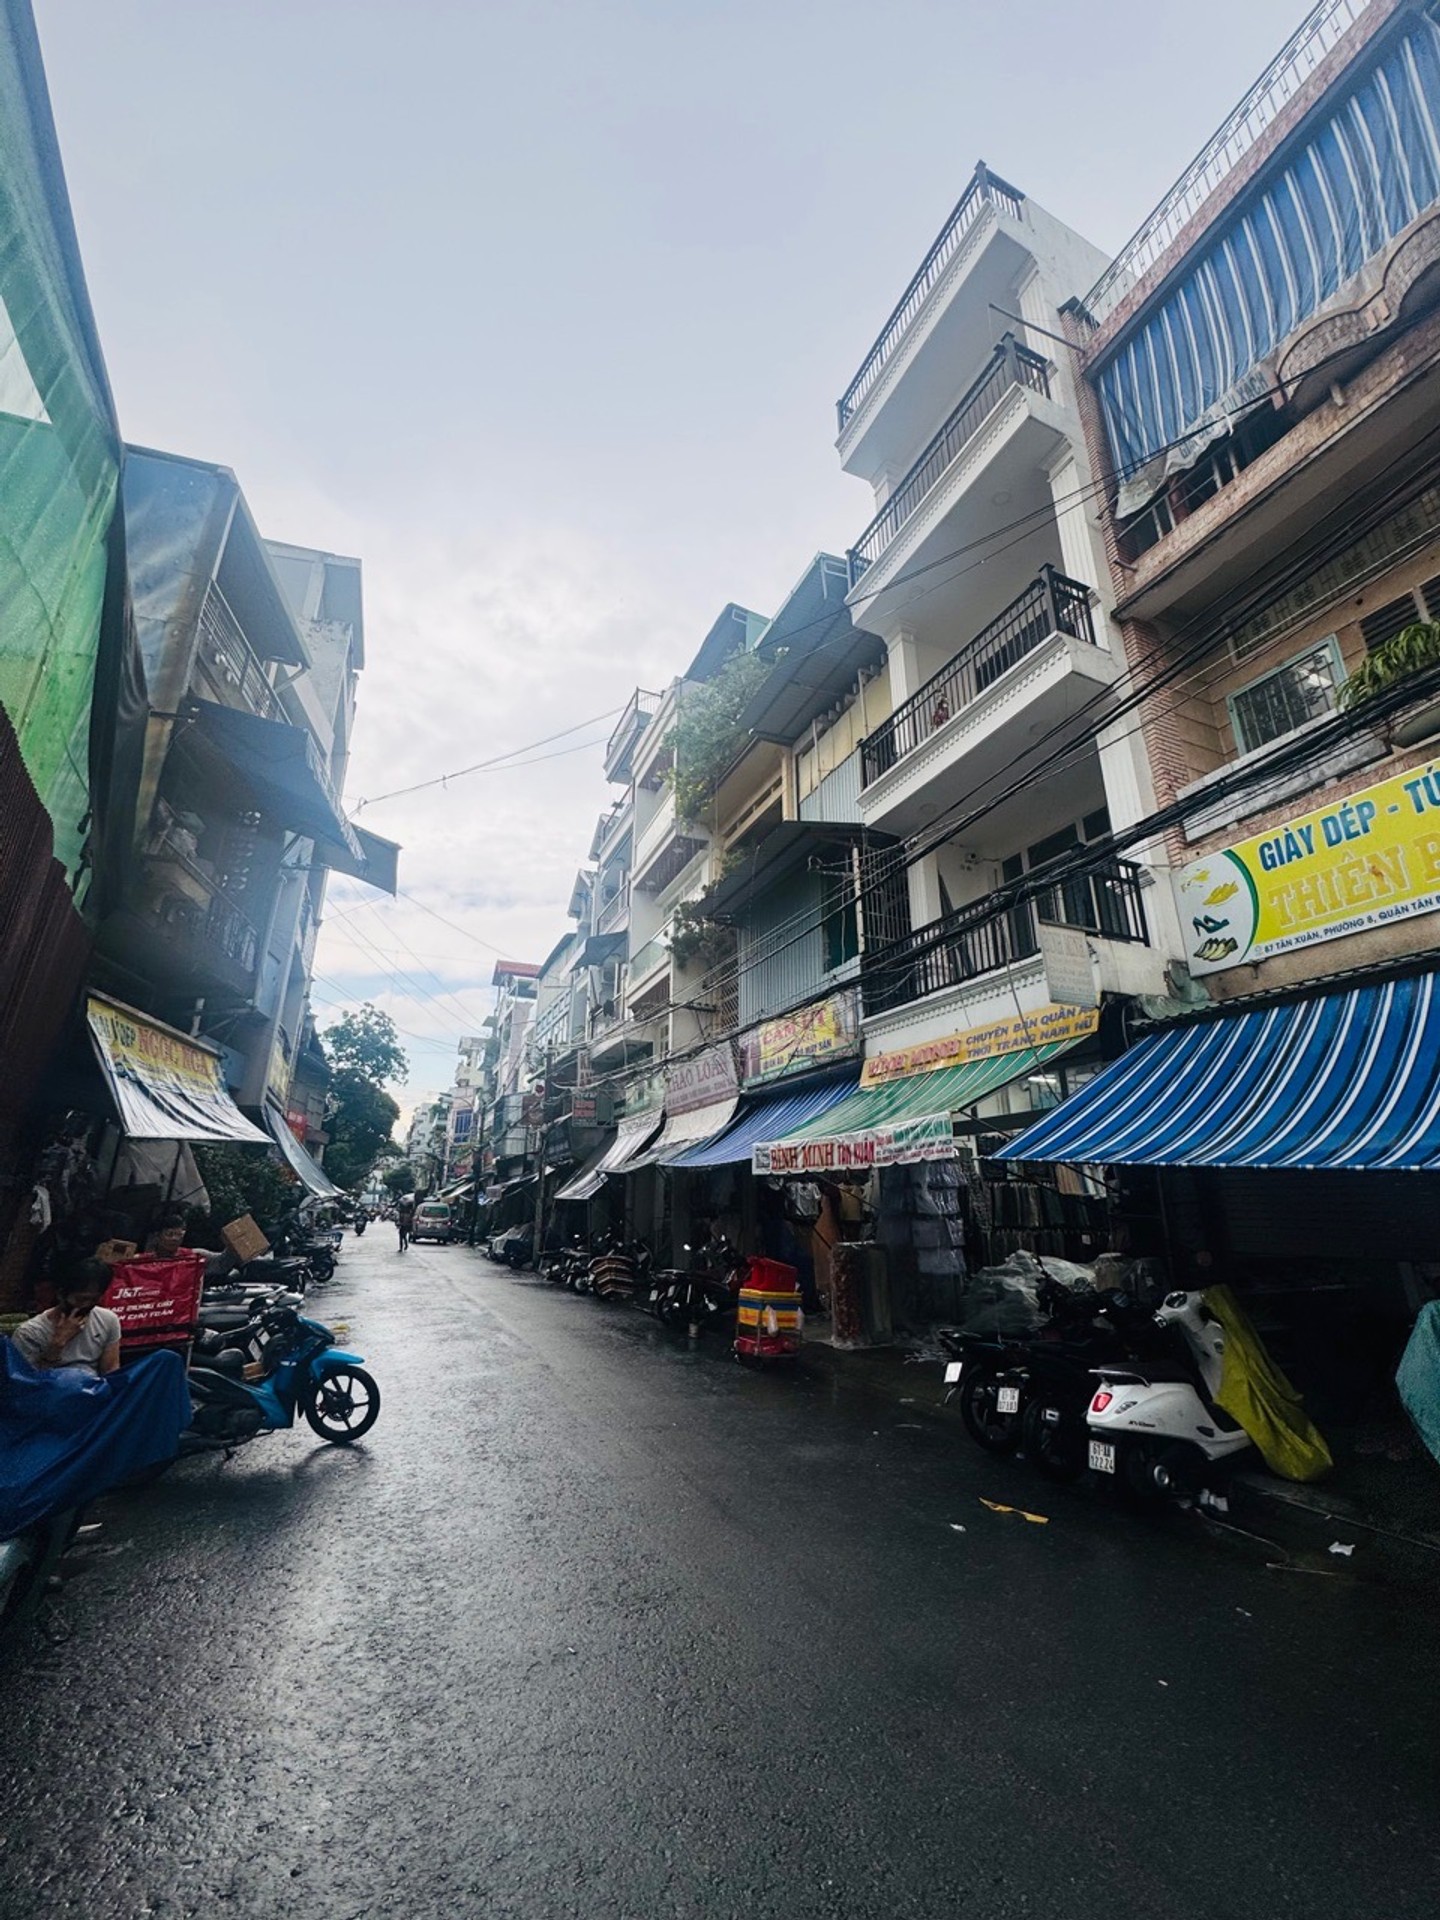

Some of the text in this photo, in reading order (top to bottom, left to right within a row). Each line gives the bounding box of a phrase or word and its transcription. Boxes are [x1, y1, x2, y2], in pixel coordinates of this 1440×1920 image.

[1258, 824, 1314, 871] GIÀY
[1321, 800, 1375, 846] DÉP
[1268, 845, 1411, 929] THIÊN
[1275, 939, 1293, 950] TÂN
[1378, 905, 1410, 920] QUẬN
[1411, 898, 1434, 910] TÂN
[966, 1026, 1009, 1045] CHUYÊN
[1012, 1017, 1038, 1033] BÁN
[1040, 1006, 1076, 1025] QUẦN
[996, 1034, 1036, 1051] TRANG
[1039, 1026, 1070, 1041] NAM
[770, 1143, 798, 1170] BÌNH
[802, 1143, 835, 1168] MINH
